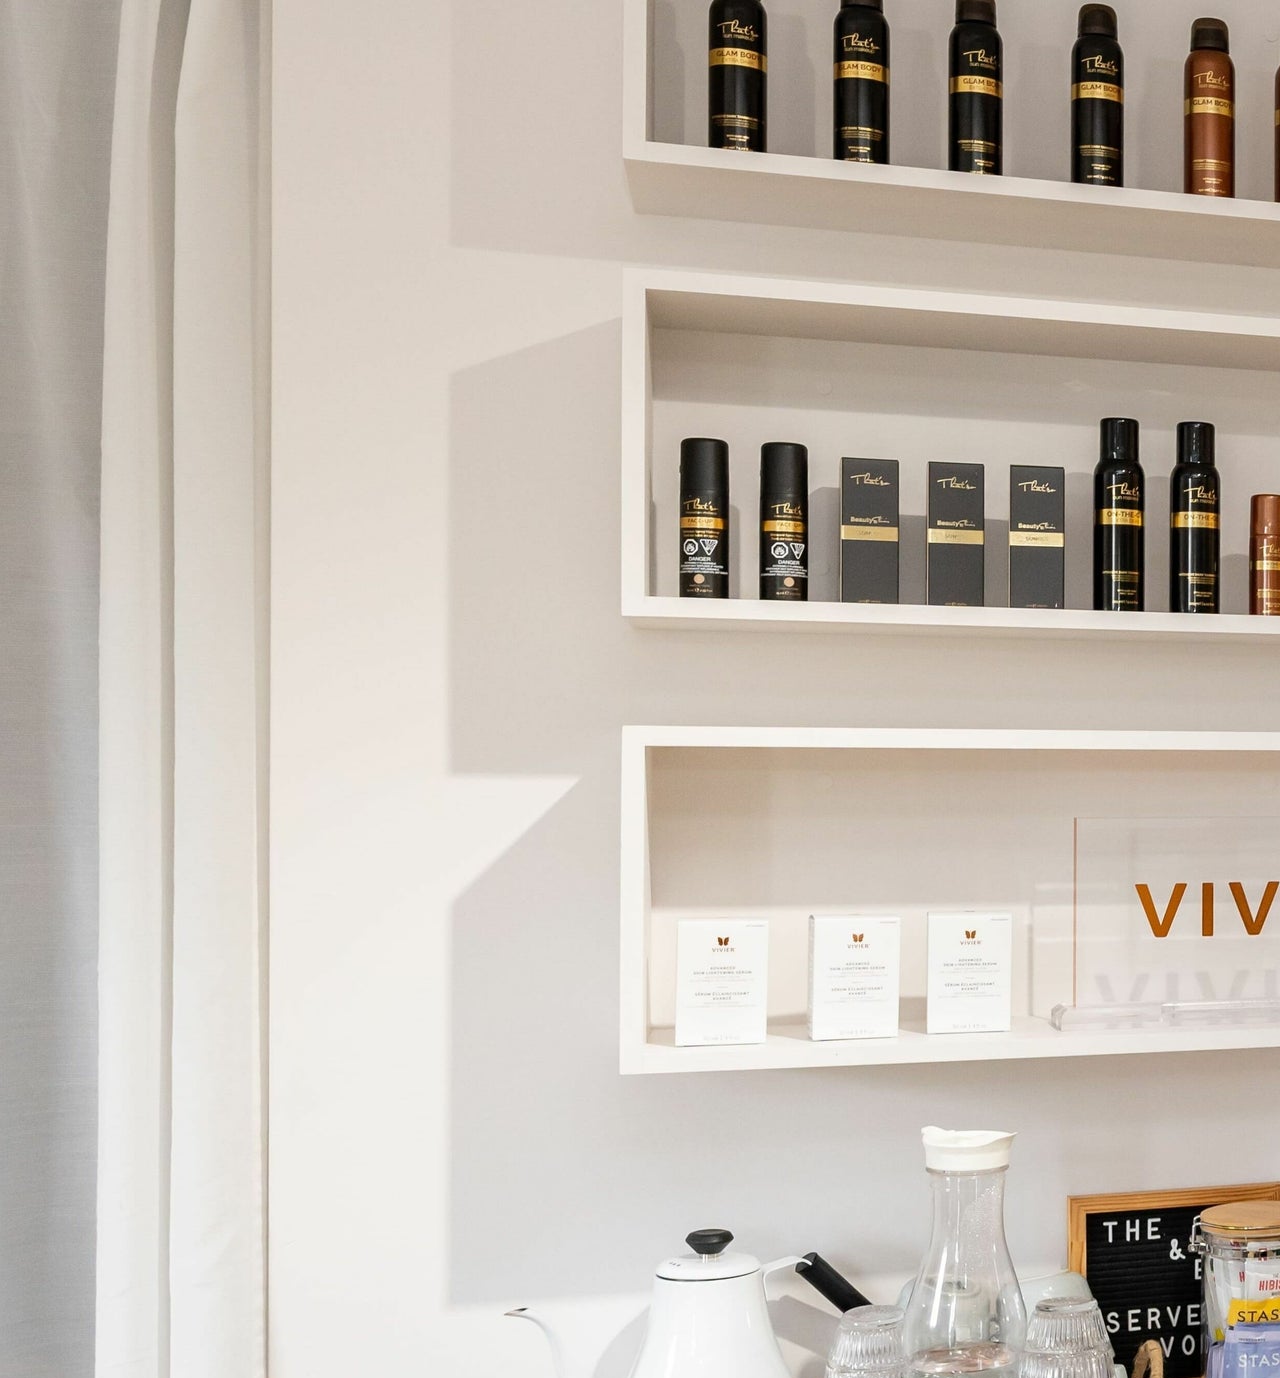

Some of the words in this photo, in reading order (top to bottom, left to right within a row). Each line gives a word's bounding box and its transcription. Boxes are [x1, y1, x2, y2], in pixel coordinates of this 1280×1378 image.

[716, 50, 738, 58] GLAM
[860, 63, 882, 72] BODY
[962, 77, 985, 85] GLAM
[1080, 83, 1101, 91] GLAM
[1103, 1218, 1162, 1243] THE
[1169, 1239, 1187, 1260] &
